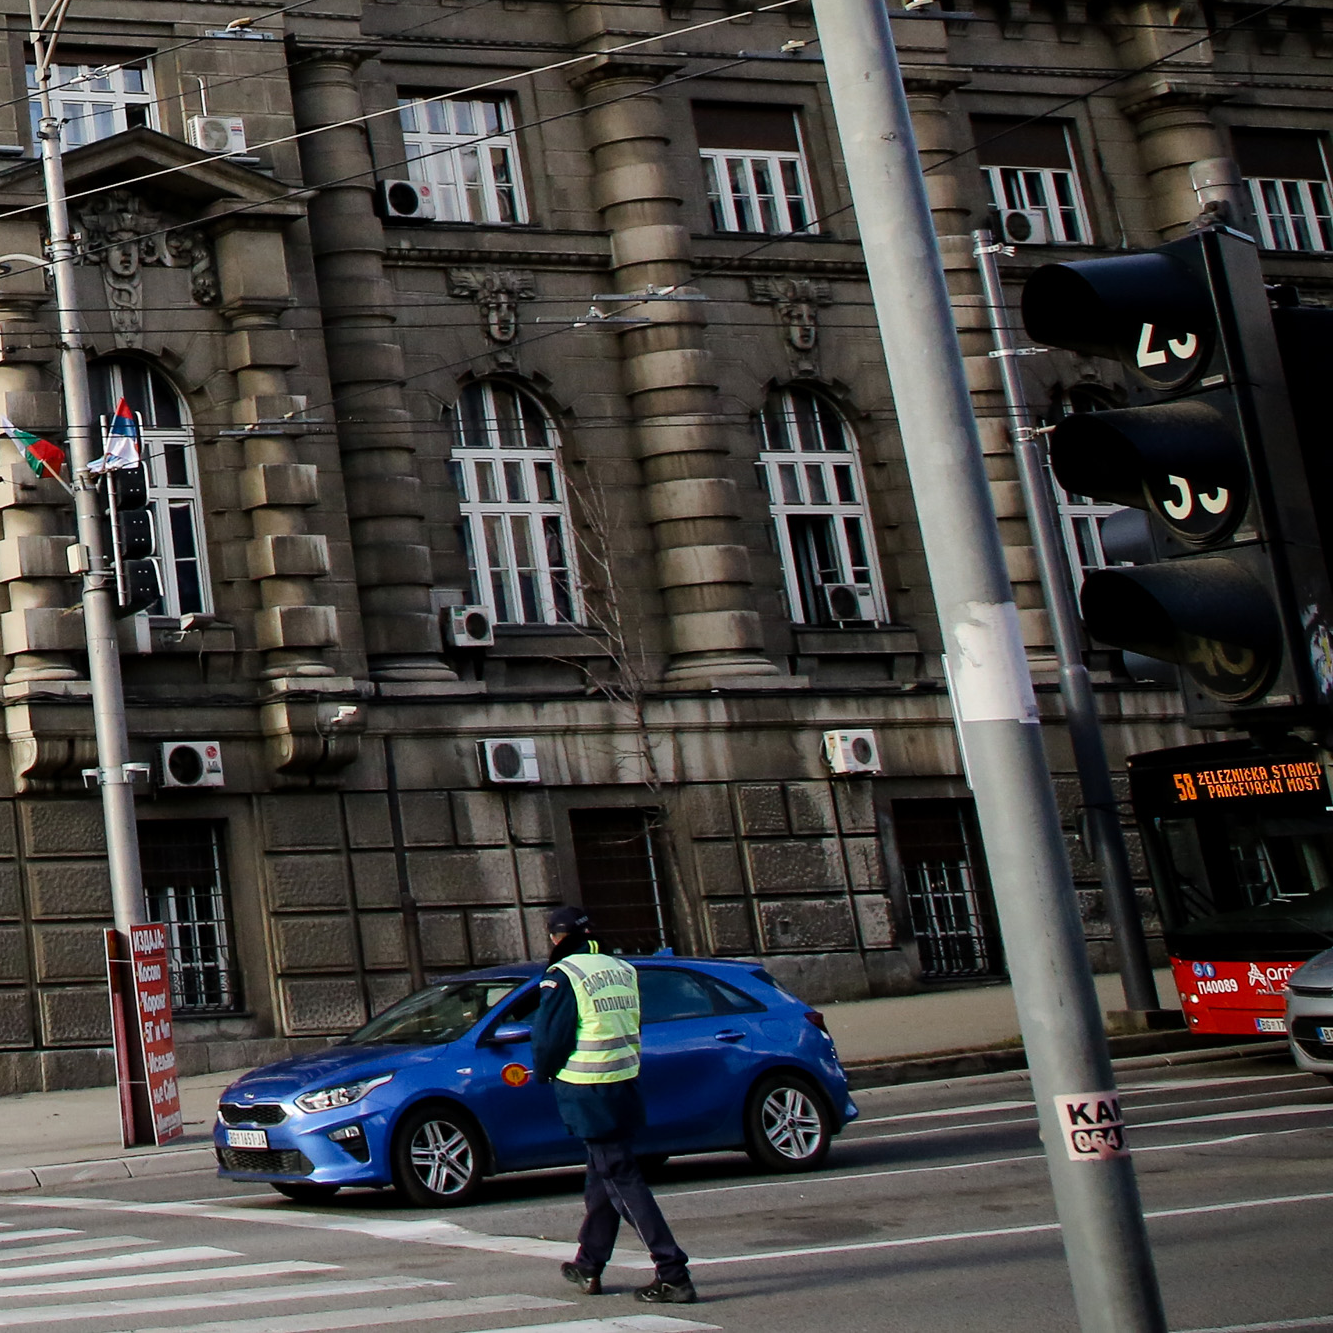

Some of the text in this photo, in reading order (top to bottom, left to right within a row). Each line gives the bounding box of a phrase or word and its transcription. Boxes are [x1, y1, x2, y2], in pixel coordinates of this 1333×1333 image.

[1196, 767, 1268, 786] ŽELEZNIČKA
[1287, 776, 1321, 792] MOST
[1173, 773, 1198, 801] 58
[1197, 978, 1239, 995] П40089
